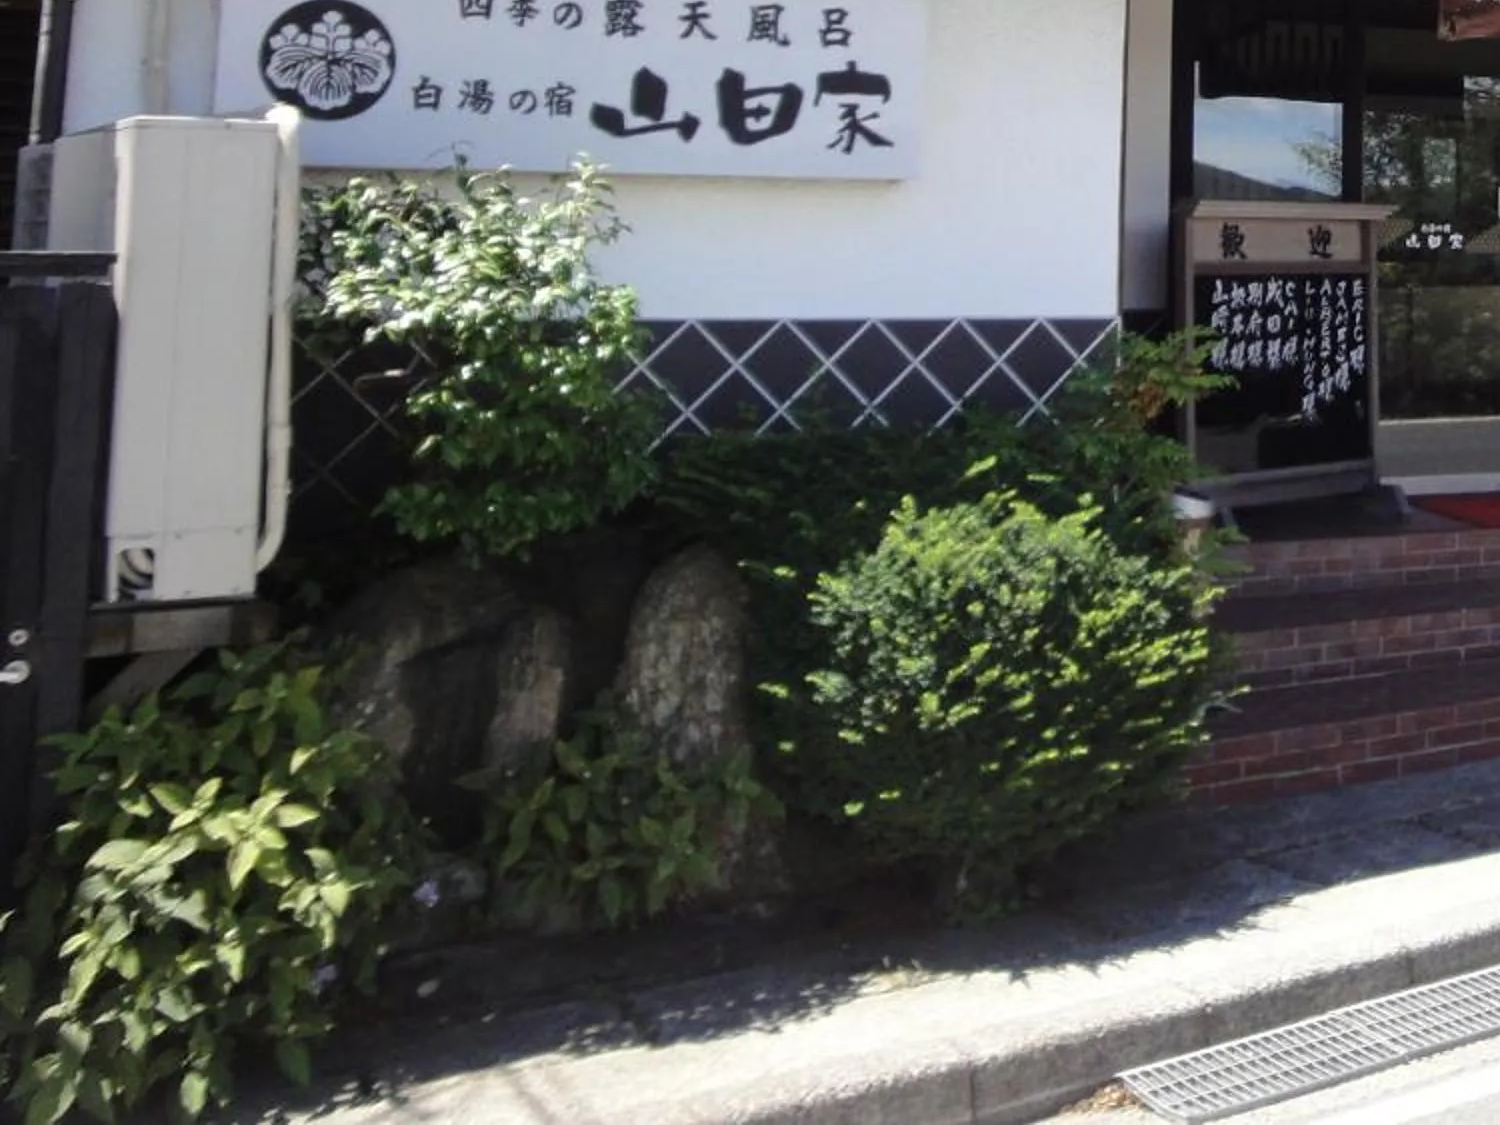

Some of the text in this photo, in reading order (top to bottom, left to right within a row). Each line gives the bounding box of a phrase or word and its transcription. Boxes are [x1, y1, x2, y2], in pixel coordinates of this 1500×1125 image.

[411, 59, 894, 154] 白湯の宿 山田家
